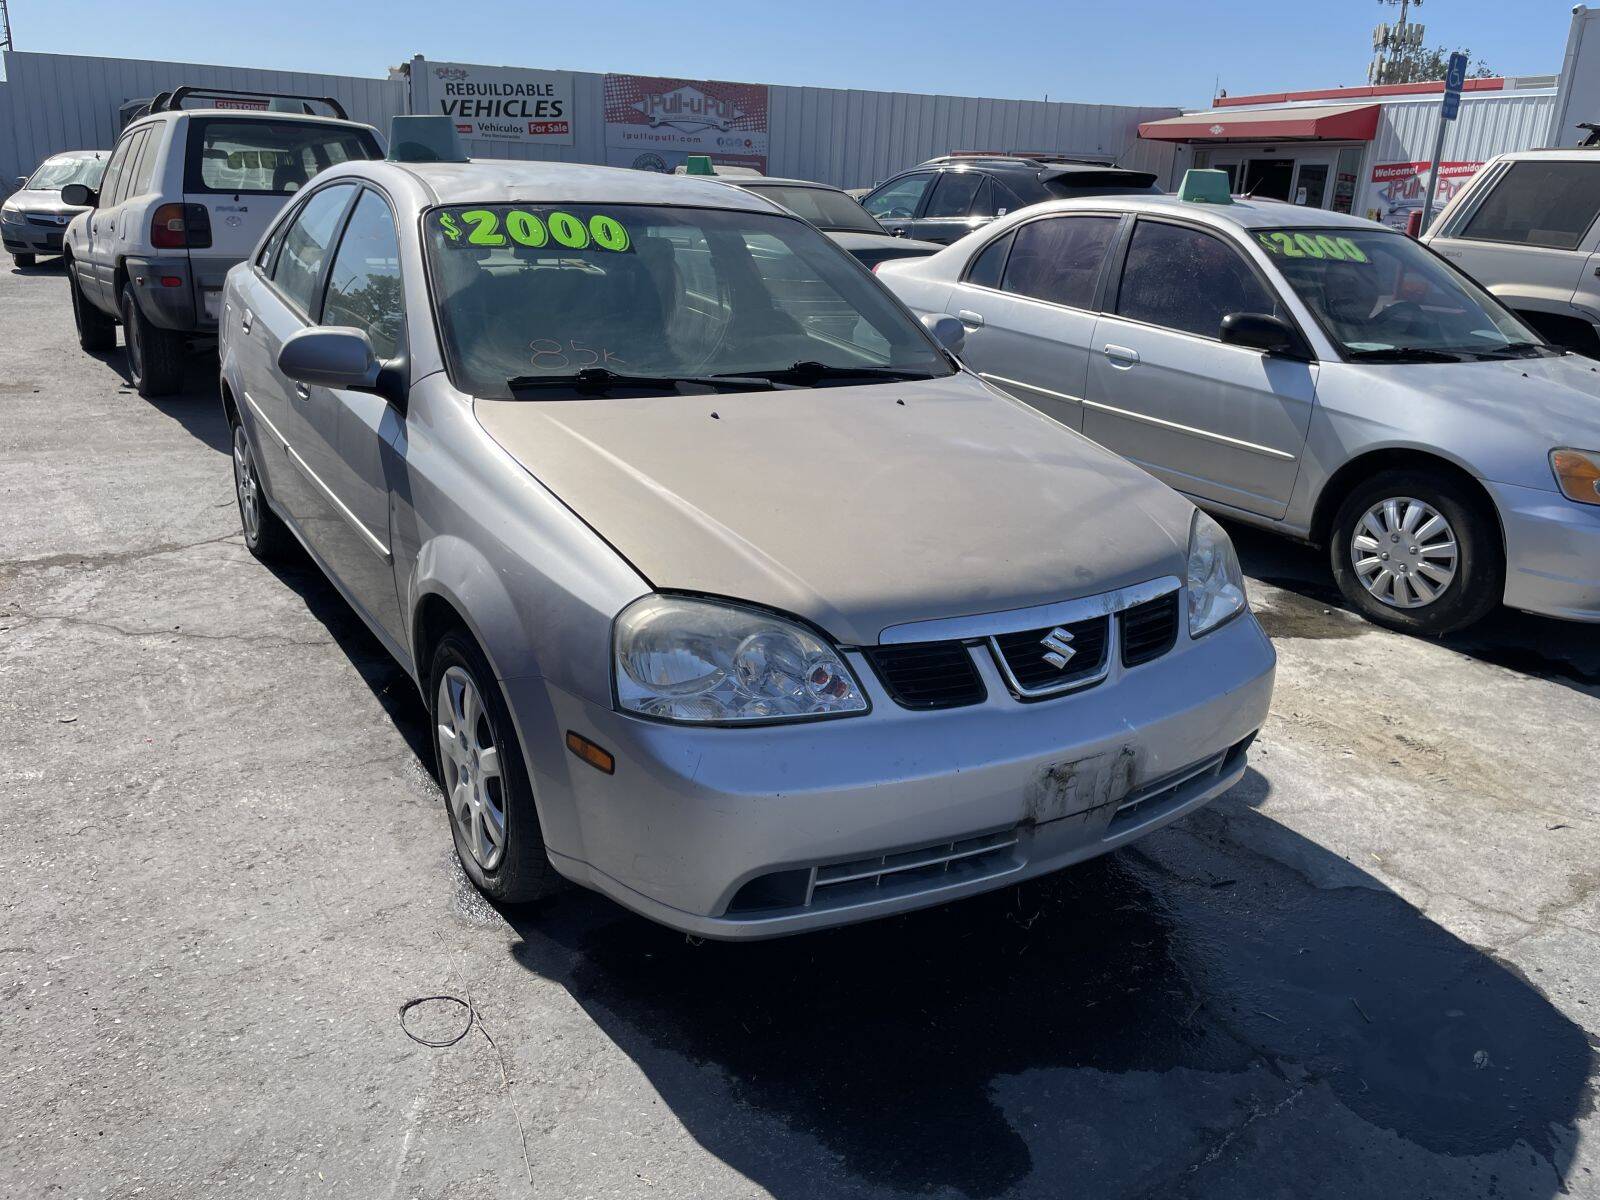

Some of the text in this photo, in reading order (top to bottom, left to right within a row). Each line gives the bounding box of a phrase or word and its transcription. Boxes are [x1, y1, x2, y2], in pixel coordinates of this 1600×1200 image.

[445, 82, 554, 97] REBUILDABLE
[440, 99, 563, 118] VEHICLES
[530, 123, 568, 133] For Sale
[1375, 165, 1418, 178] Welcome!
[439, 210, 630, 252] $2000
[1258, 232, 1368, 263] $2000
